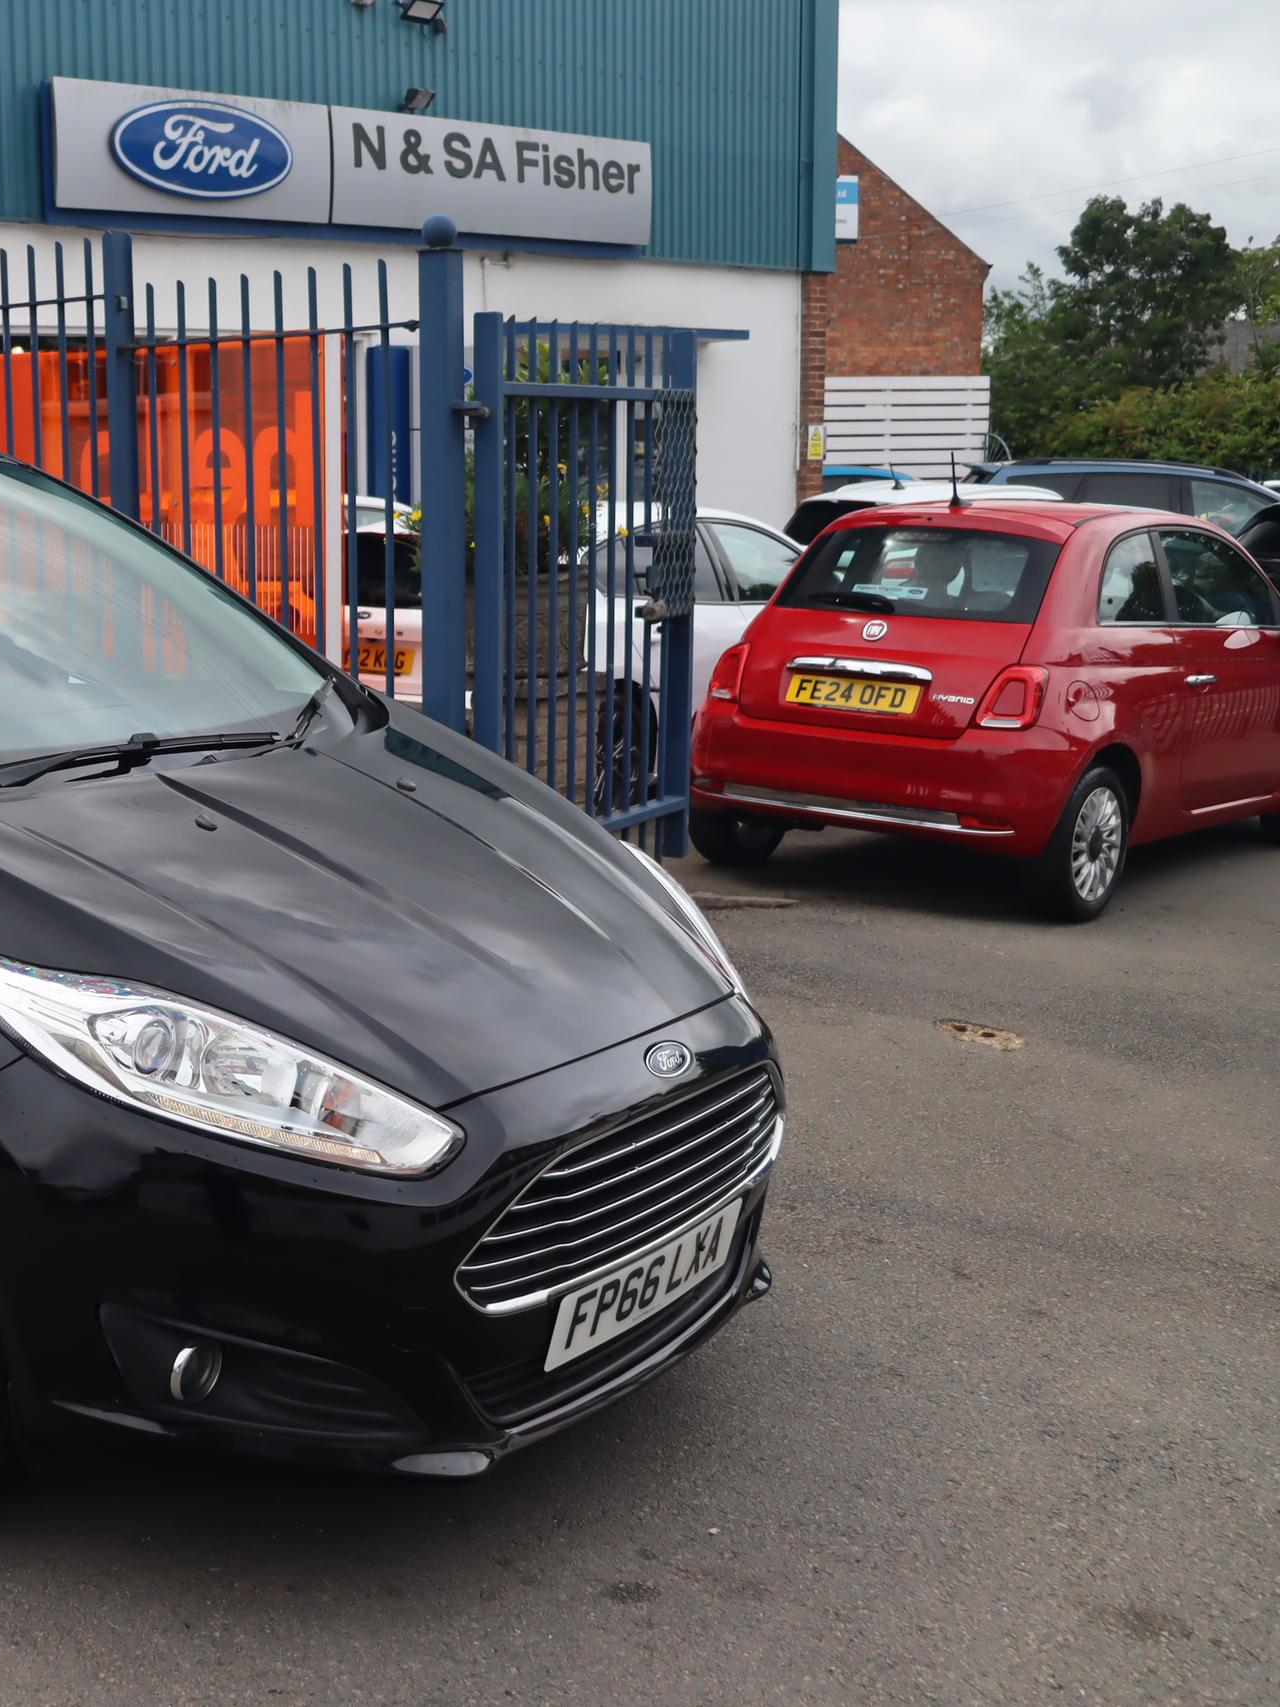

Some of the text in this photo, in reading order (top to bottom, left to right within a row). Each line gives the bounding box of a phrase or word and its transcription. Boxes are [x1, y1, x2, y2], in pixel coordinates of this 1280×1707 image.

[153, 114, 261, 178] Ford
[352, 122, 641, 194] N & SA Fisher
[373, 649, 405, 669] KG
[795, 679, 907, 708] FE24 OFD
[932, 694, 974, 705] HYBRID
[657, 1050, 682, 1070] Ford
[564, 1216, 724, 1350] FP66 LXA
